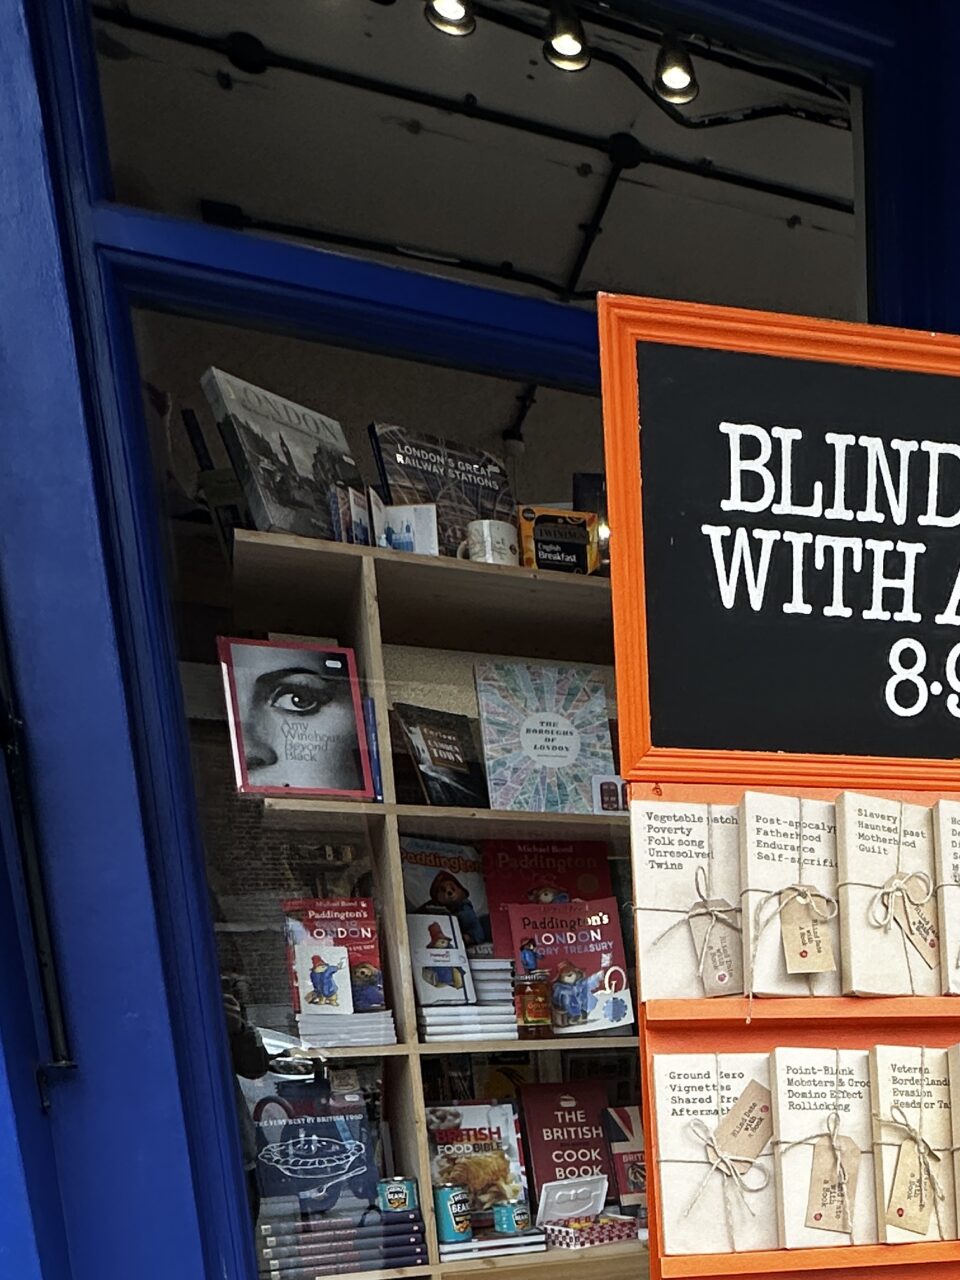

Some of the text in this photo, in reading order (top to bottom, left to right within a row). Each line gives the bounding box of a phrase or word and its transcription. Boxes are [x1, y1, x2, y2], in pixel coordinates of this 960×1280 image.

[398, 444, 493, 477] LONDON'S GREAT
[396, 453, 499, 490] RAILWAY STATIONS
[538, 543, 561, 553] English
[538, 551, 576, 563] Breakfast
[701, 524, 927, 622] WITH
[281, 719, 309, 731] Amy
[285, 750, 317, 762] Black
[646, 812, 703, 823] Vegetable
[858, 809, 898, 824] Slavery
[647, 825, 692, 836] Poverty
[756, 828, 821, 842] Fatherhood
[858, 821, 926, 839] Haunted past
[648, 836, 704, 849] Folk song
[649, 848, 714, 860] Unresolved
[859, 845, 888, 855] Guilt
[497, 853, 597, 868] Paddington
[650, 860, 683, 870] Twins
[308, 911, 368, 920] Paddington's
[522, 913, 609, 930] Paddington's
[535, 929, 601, 945] LONDON
[563, 942, 613, 954] TREASURY
[891, 1064, 929, 1074] Veteran
[669, 1071, 710, 1080] Ground
[787, 1079, 835, 1087] Mobsters
[788, 1090, 827, 1099] Domino
[893, 1088, 932, 1098] Evasion
[671, 1096, 712, 1104] Shared
[789, 1102, 851, 1112] Rollicking
[555, 1110, 586, 1124] THE
[744, 1116, 756, 1132] with
[435, 1126, 502, 1143] BRITISH
[543, 1126, 604, 1141] BRITISH
[552, 1149, 603, 1163] COOK
[556, 1165, 604, 1180] BOOK
